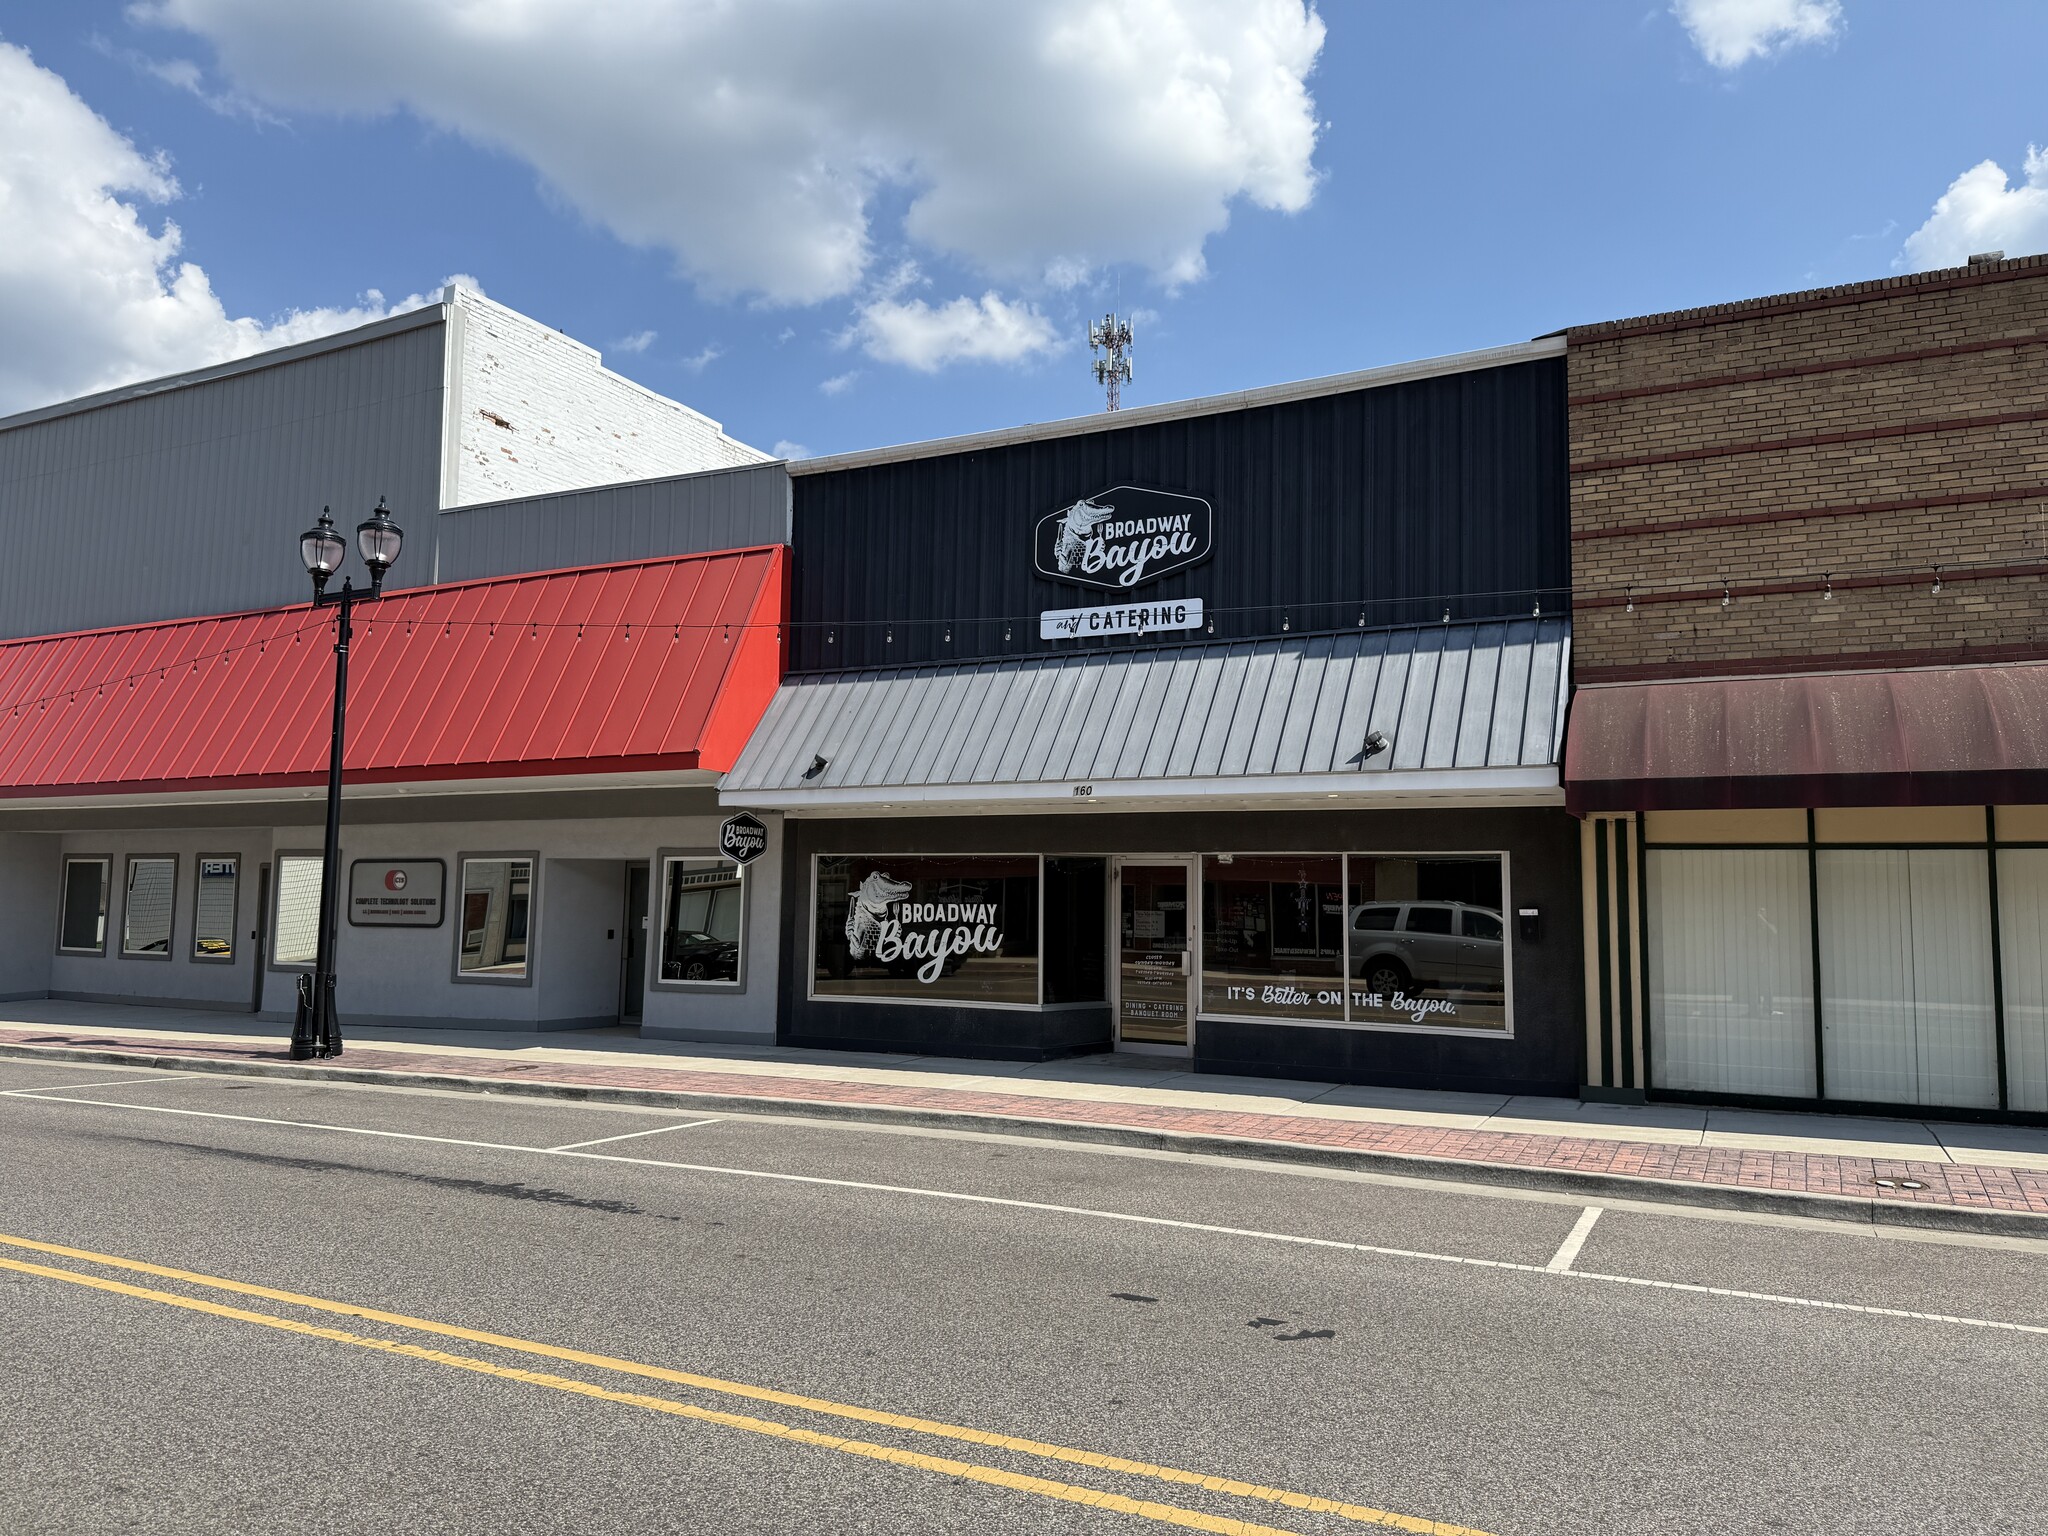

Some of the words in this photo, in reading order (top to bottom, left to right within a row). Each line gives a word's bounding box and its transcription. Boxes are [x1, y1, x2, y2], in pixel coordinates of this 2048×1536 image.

[1105, 513, 1192, 540] BROADWAY
[1080, 531, 1197, 587] Bayou
[1056, 612, 1083, 634] and
[1089, 605, 1186, 631] CATERING
[1073, 785, 1093, 796] 160
[724, 823, 765, 857] Bayou
[736, 825, 764, 836] BROADWAY
[355, 897, 379, 905] COMPLETE
[380, 897, 409, 905] TECHNOLOGY
[410, 898, 437, 906] SOLUTIONS
[902, 902, 998, 925] BROADWAY
[876, 920, 1003, 984] Bayou
[1130, 1009, 1159, 1017] BANQUET
[1227, 986, 1255, 1001] IT'S
[1261, 985, 1312, 1005] Better
[1317, 991, 1341, 1005] ON
[1352, 992, 1383, 1008] THE
[1390, 992, 1457, 1023] Bayou.
